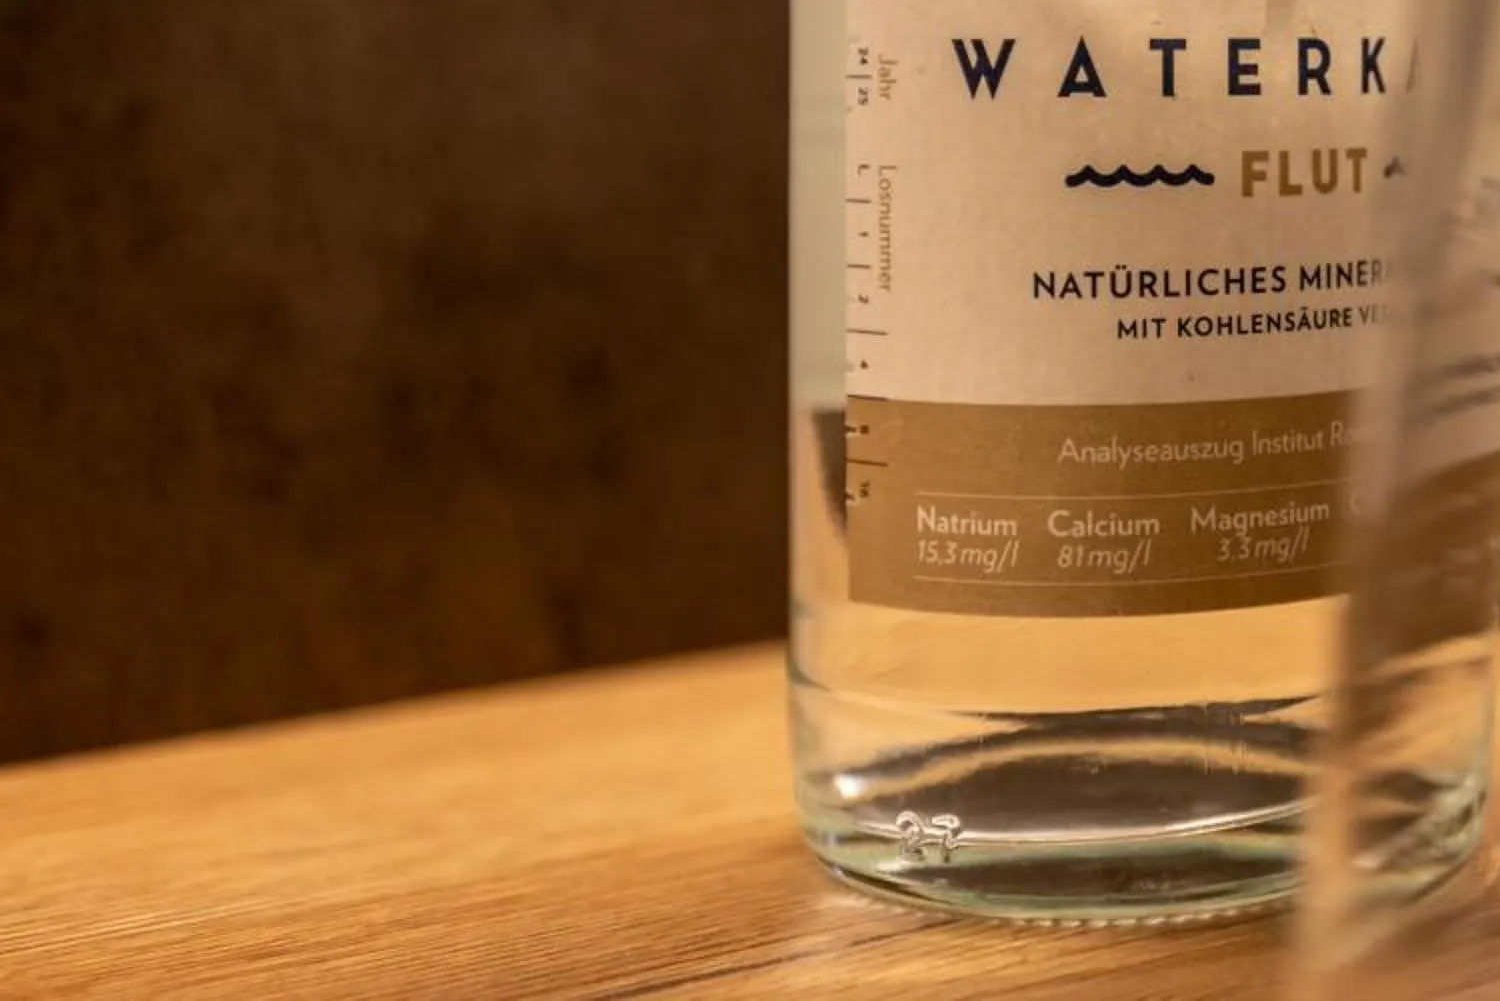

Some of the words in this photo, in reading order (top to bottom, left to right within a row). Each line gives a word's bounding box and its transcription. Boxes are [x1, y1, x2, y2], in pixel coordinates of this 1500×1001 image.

[878, 52, 898, 100] Jahr
[1241, 147, 1368, 198] FLUT
[878, 165, 897, 292] Losnummer
[1033, 264, 1286, 299] NATÜRLICHES
[1299, 259, 1392, 291] MINER
[1117, 318, 1167, 340] MIT
[1177, 307, 1353, 338] KOHLENSÄURE
[1057, 437, 1244, 470] Analyseauszug
[1252, 430, 1324, 456] Institut
[916, 504, 1018, 536] Natrium
[1047, 509, 1160, 537] Calcium
[1190, 501, 1330, 536] Magnesium
